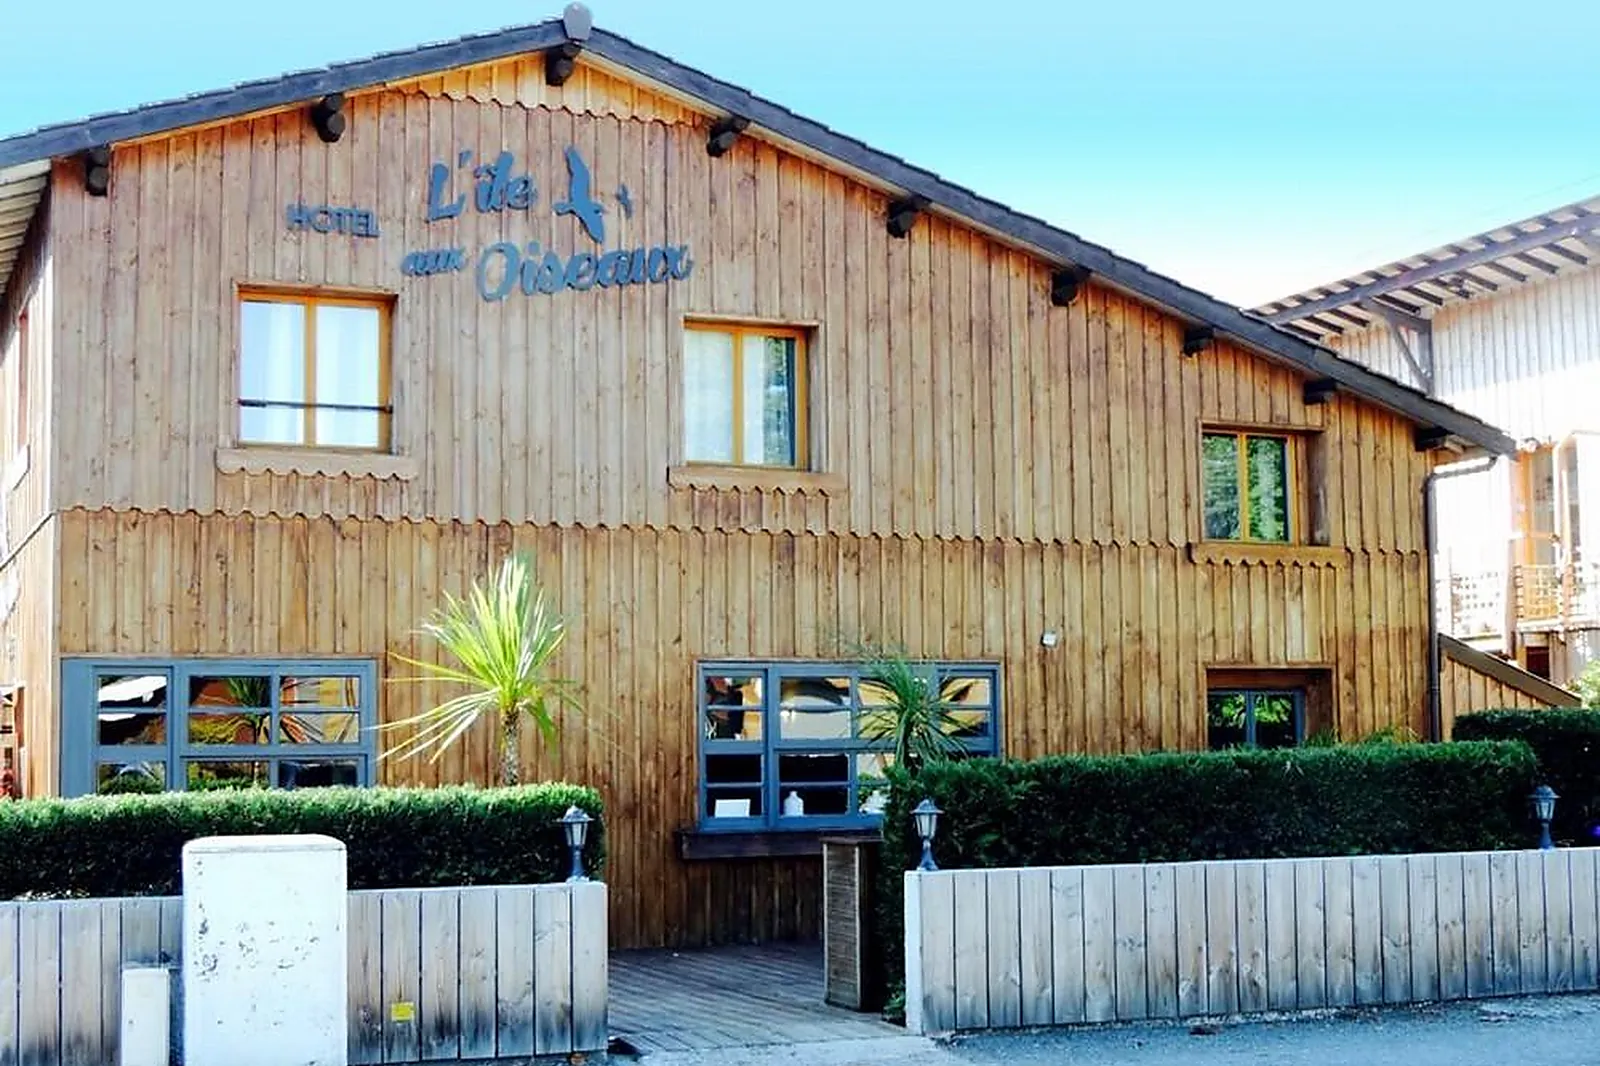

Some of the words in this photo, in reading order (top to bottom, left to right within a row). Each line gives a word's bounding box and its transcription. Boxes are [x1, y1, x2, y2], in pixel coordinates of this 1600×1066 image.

[286, 203, 380, 238] HOTEL
[401, 246, 465, 276] aux
[476, 241, 693, 302] Oiseaux
